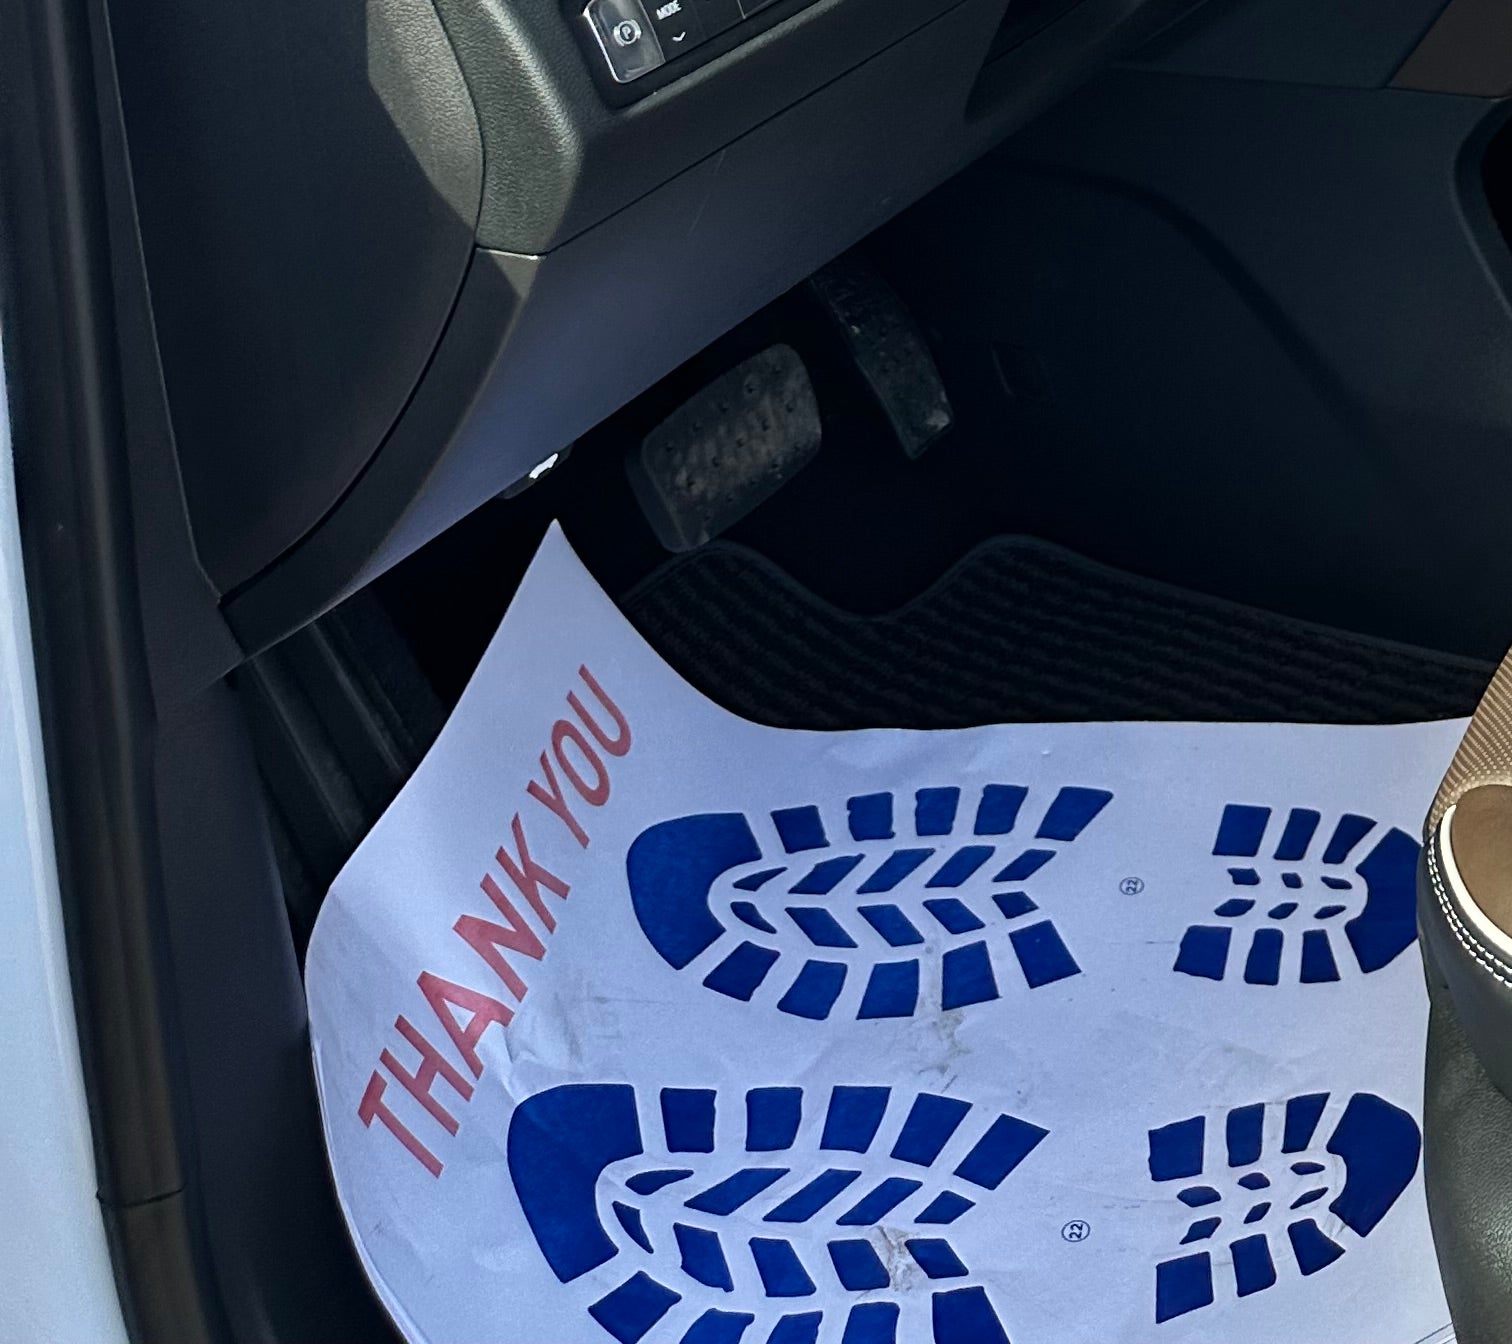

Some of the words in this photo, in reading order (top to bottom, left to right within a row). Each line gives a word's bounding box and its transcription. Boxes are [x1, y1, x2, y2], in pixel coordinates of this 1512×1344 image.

[655, 0, 682, 20] MODE
[358, 812, 570, 1179] THANK
[527, 664, 632, 849] YOU
